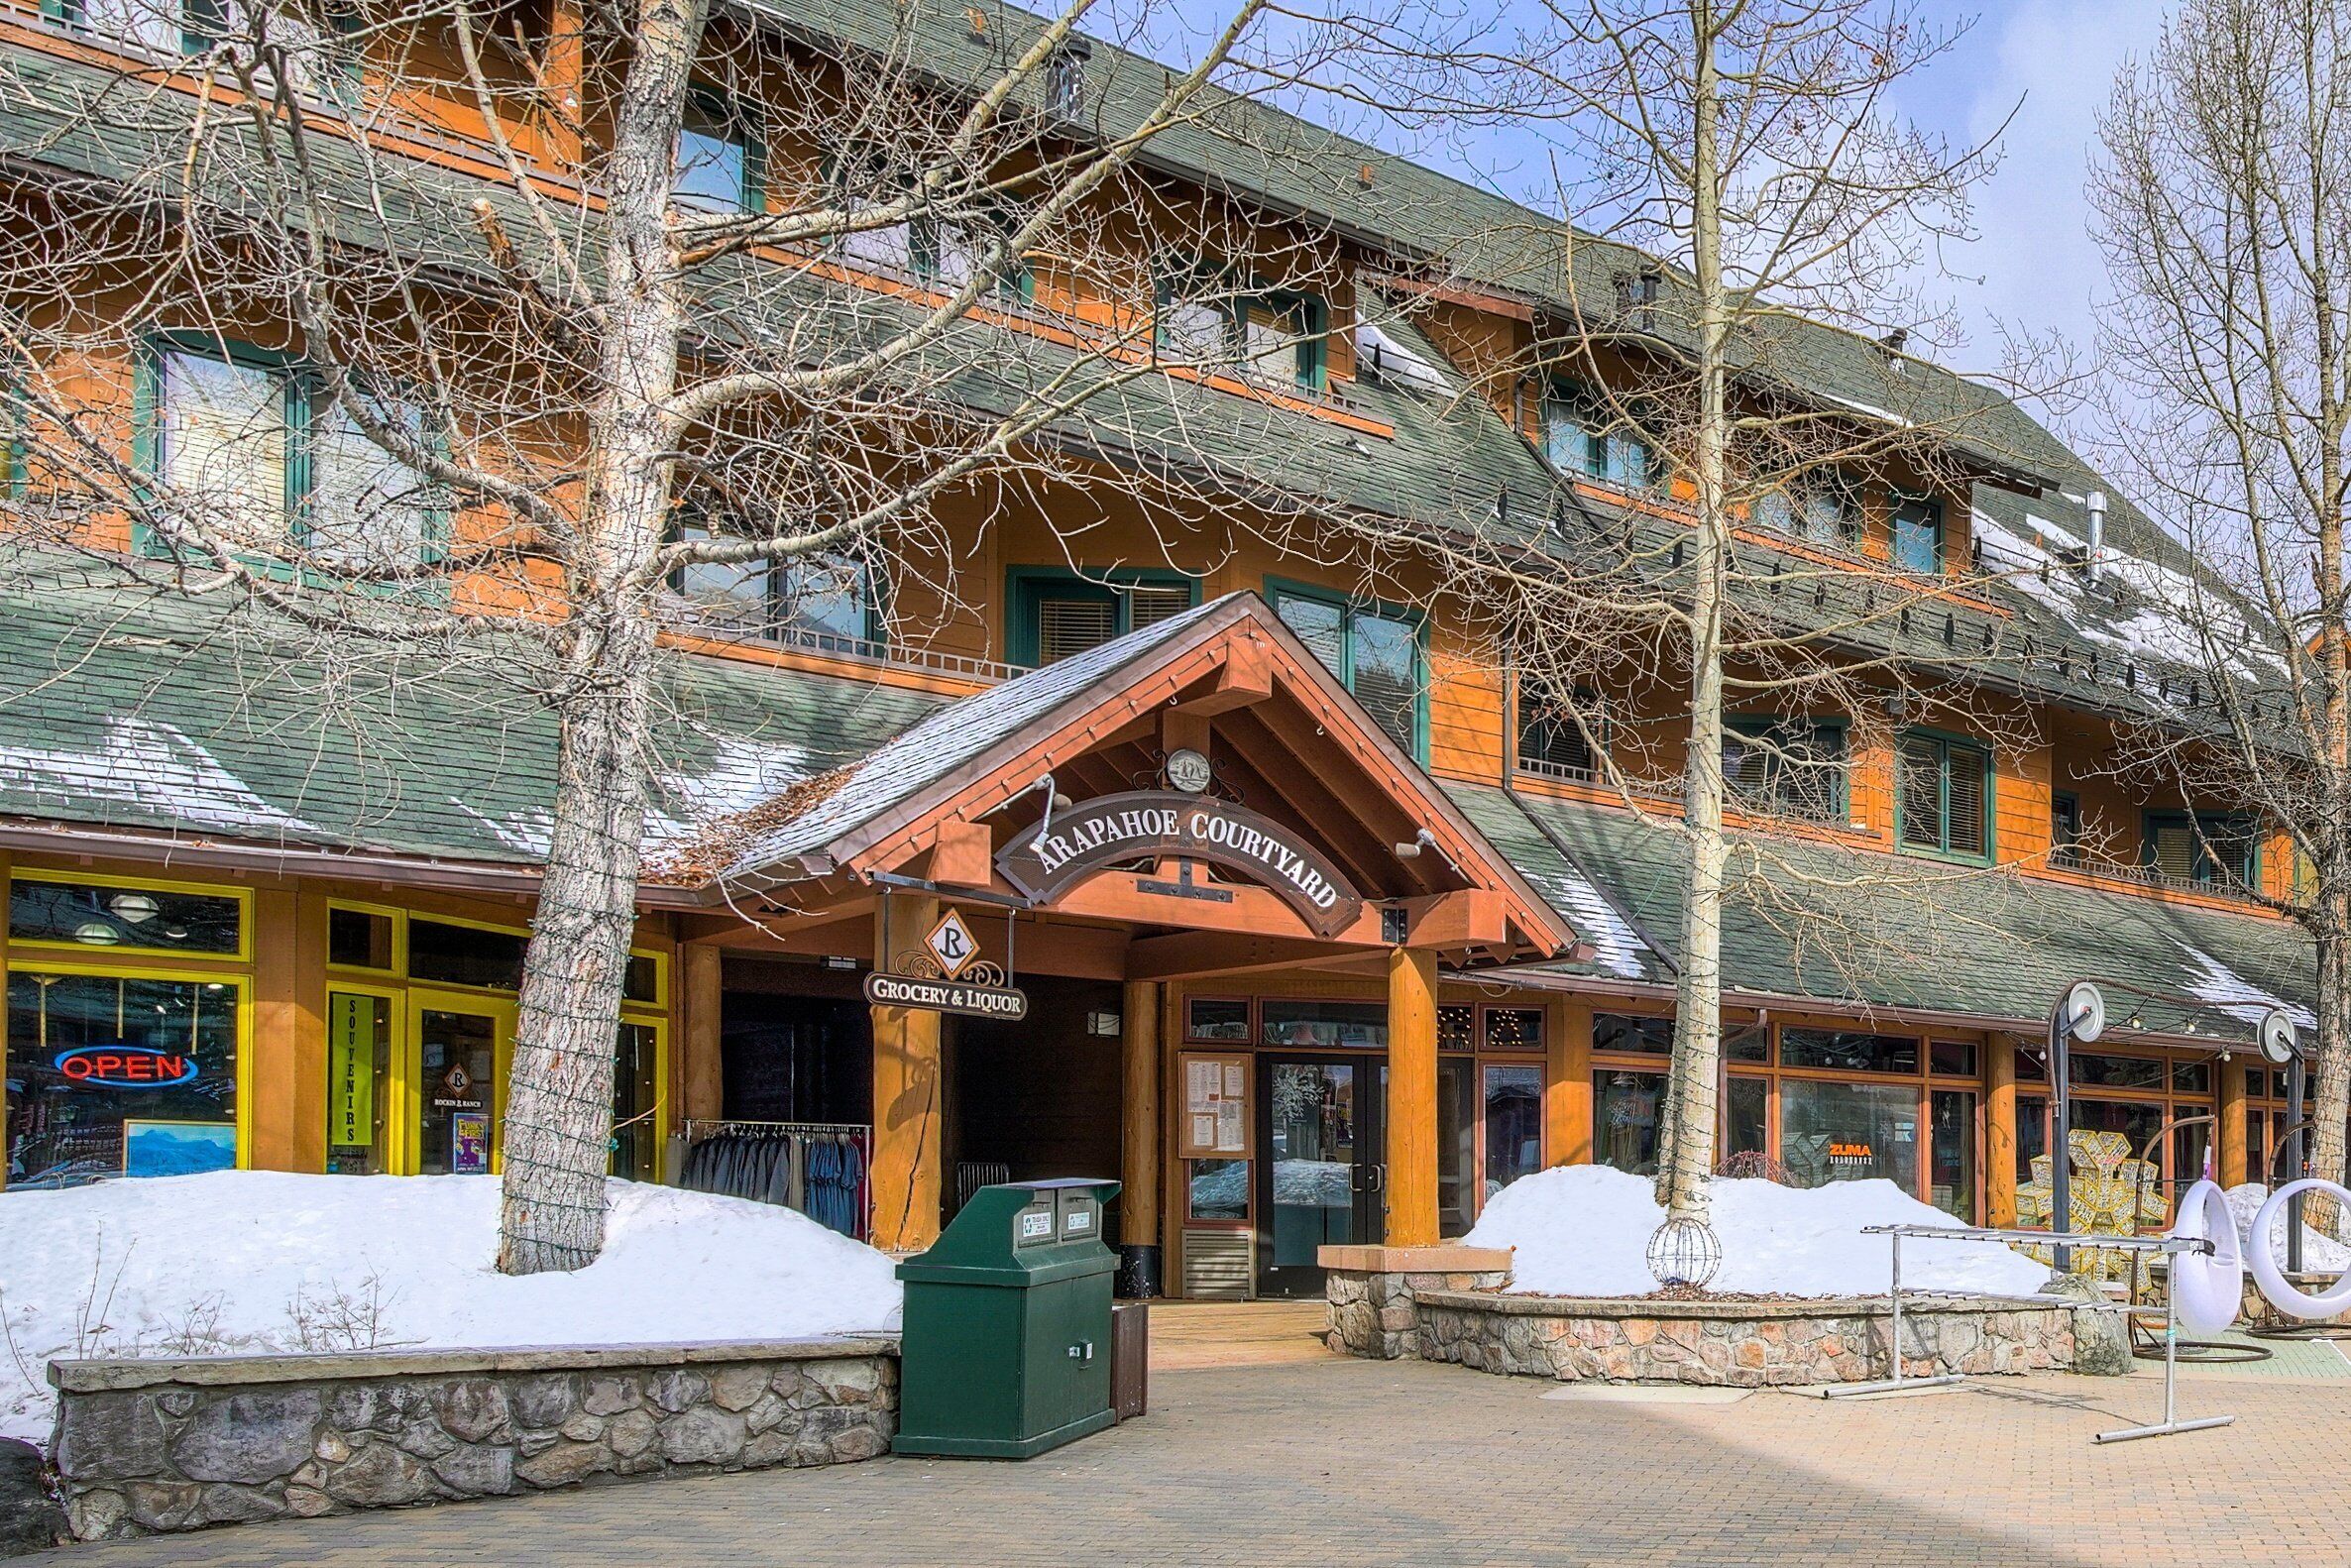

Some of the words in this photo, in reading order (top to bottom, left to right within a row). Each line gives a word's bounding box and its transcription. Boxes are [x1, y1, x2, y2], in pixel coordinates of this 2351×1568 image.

[1040, 809, 1180, 875] ARAPAHOE
[1190, 813, 1337, 908] COURTYARD
[939, 927, 966, 958] R
[873, 978, 950, 1005] GROCERY
[952, 990, 963, 1006] &
[966, 990, 1021, 1013] LIQUOR
[61, 1056, 182, 1080] OPEN
[346, 999, 356, 1141] SOUVENIRS
[1829, 1144, 1871, 1156] ZUMA
